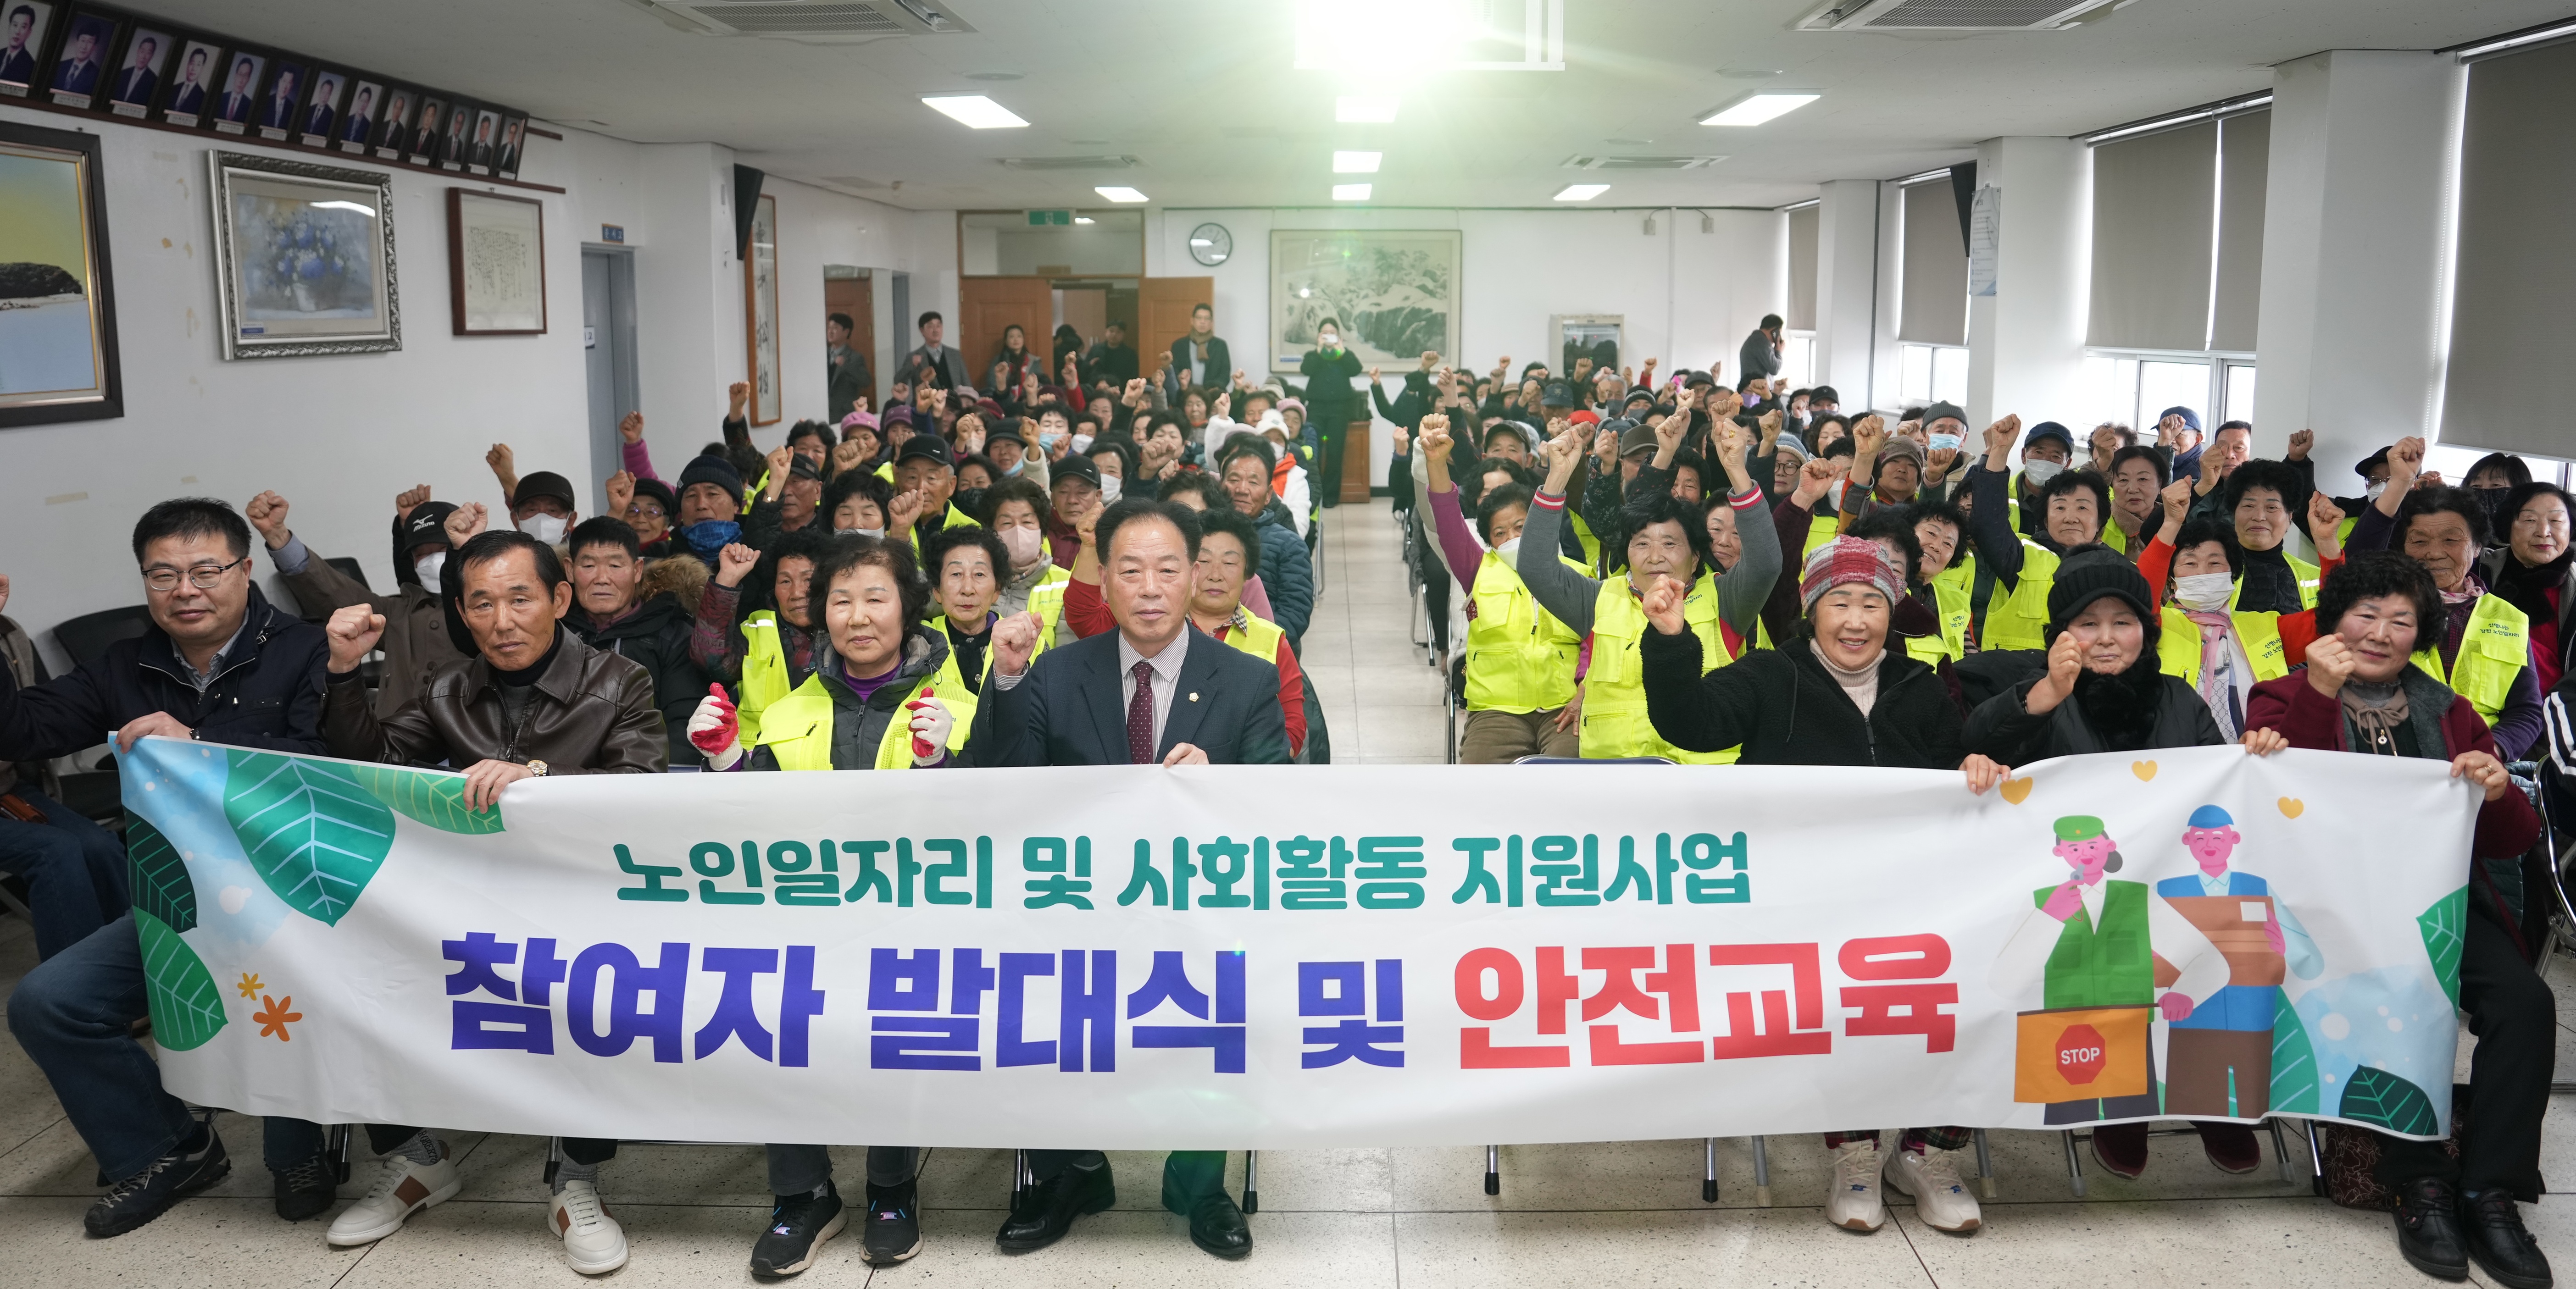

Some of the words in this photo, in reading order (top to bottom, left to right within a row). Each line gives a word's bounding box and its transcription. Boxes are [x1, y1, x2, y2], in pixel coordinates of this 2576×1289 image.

[2265, 637, 2282, 649] 신명나는
[2262, 650, 2273, 658] 강진
[614, 838, 992, 908] 노인일자리
[1023, 836, 1094, 909] 및
[1117, 835, 1426, 910] 사회활동
[1452, 832, 1750, 907] 지원사업
[442, 932, 825, 1067] 참여자
[868, 948, 1245, 1073] 발대식
[1299, 960, 1404, 1068] 및
[1455, 934, 1958, 1068] 안전교육
[2061, 1047, 2100, 1064] STOP
